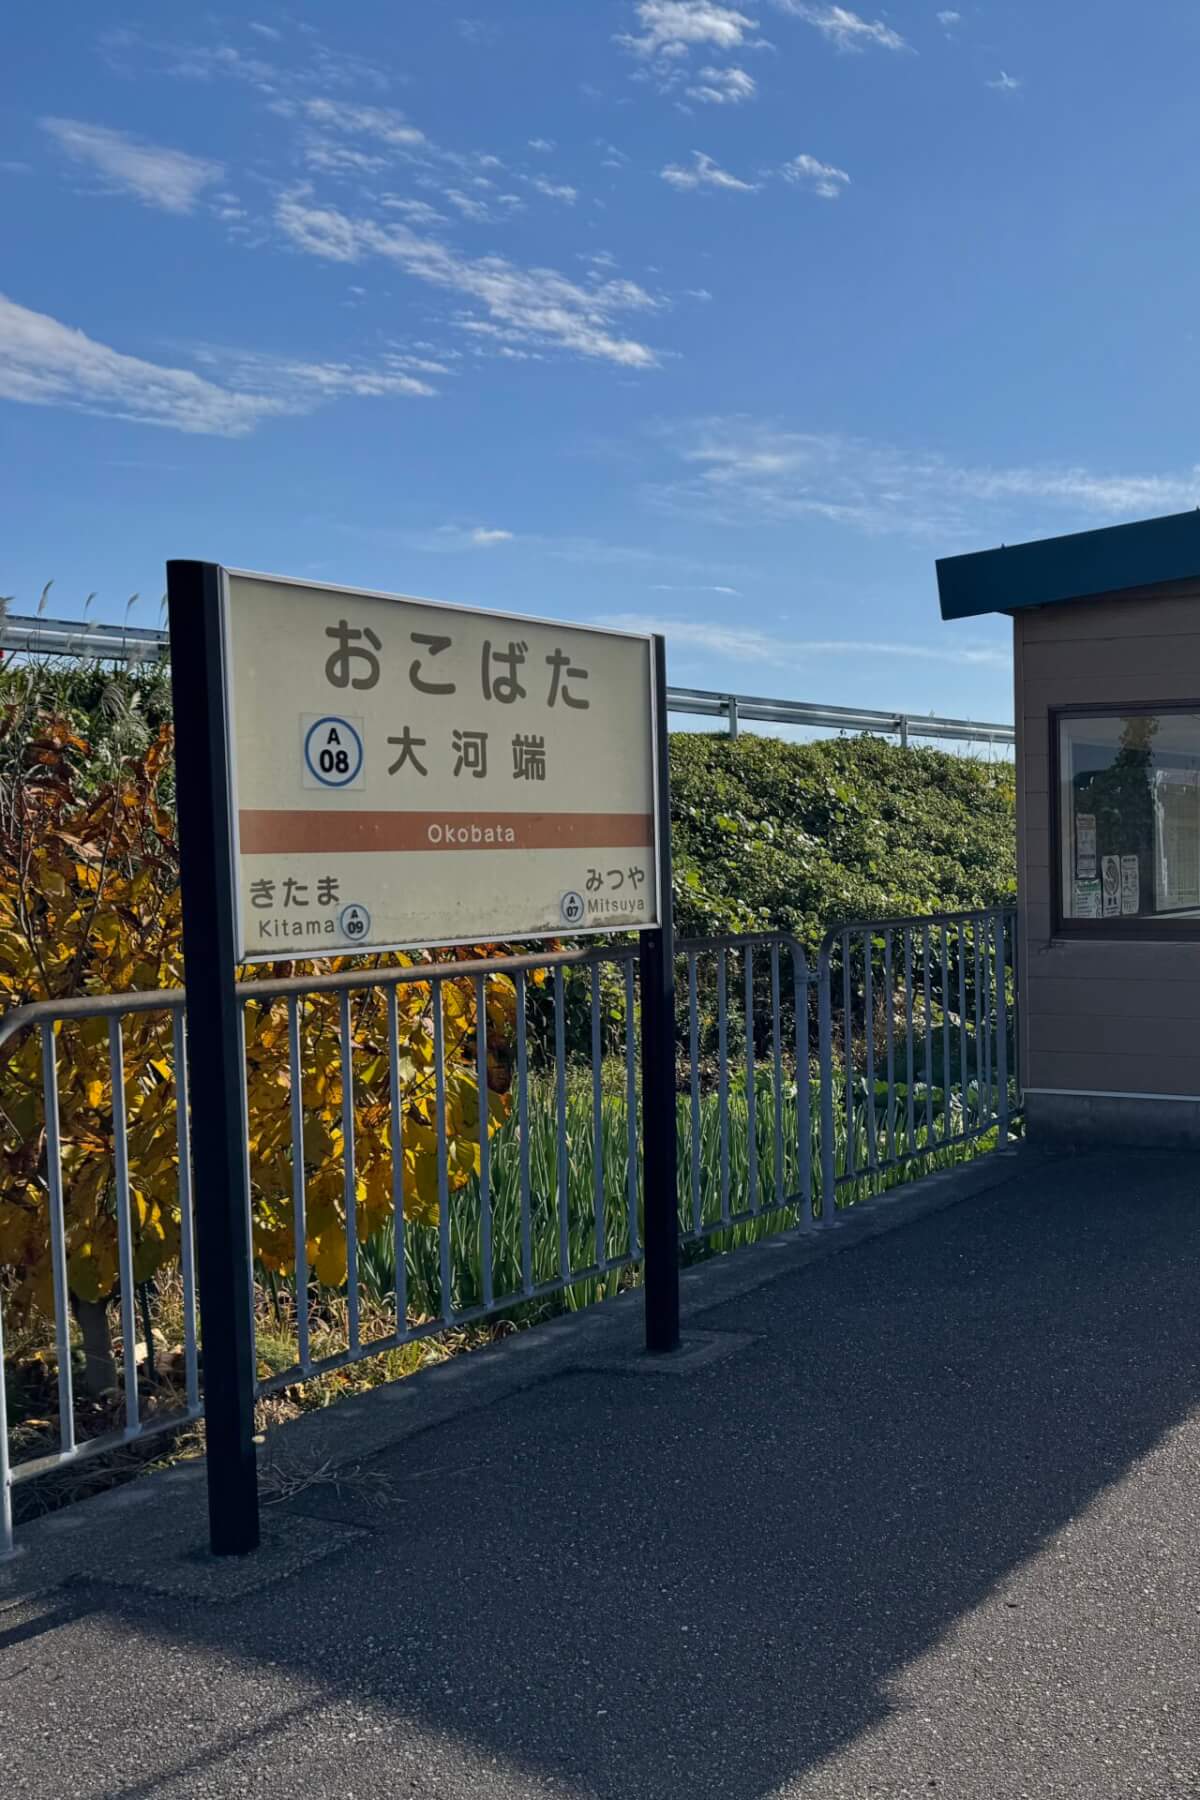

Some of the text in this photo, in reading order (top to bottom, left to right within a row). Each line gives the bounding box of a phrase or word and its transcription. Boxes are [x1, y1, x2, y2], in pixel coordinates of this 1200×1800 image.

[324, 619, 590, 710] おこばた
[326, 727, 341, 746] A
[319, 748, 350, 774] 08
[386, 726, 546, 781] 大河端
[427, 823, 515, 844] Okobata
[585, 866, 646, 892] みつや
[249, 875, 340, 909] きたま
[569, 896, 576, 904] A
[351, 909, 359, 919] A
[567, 906, 579, 917] 07
[587, 898, 645, 914] Mitsuya
[258, 919, 336, 938] Kitama
[347, 921, 364, 934] 09
